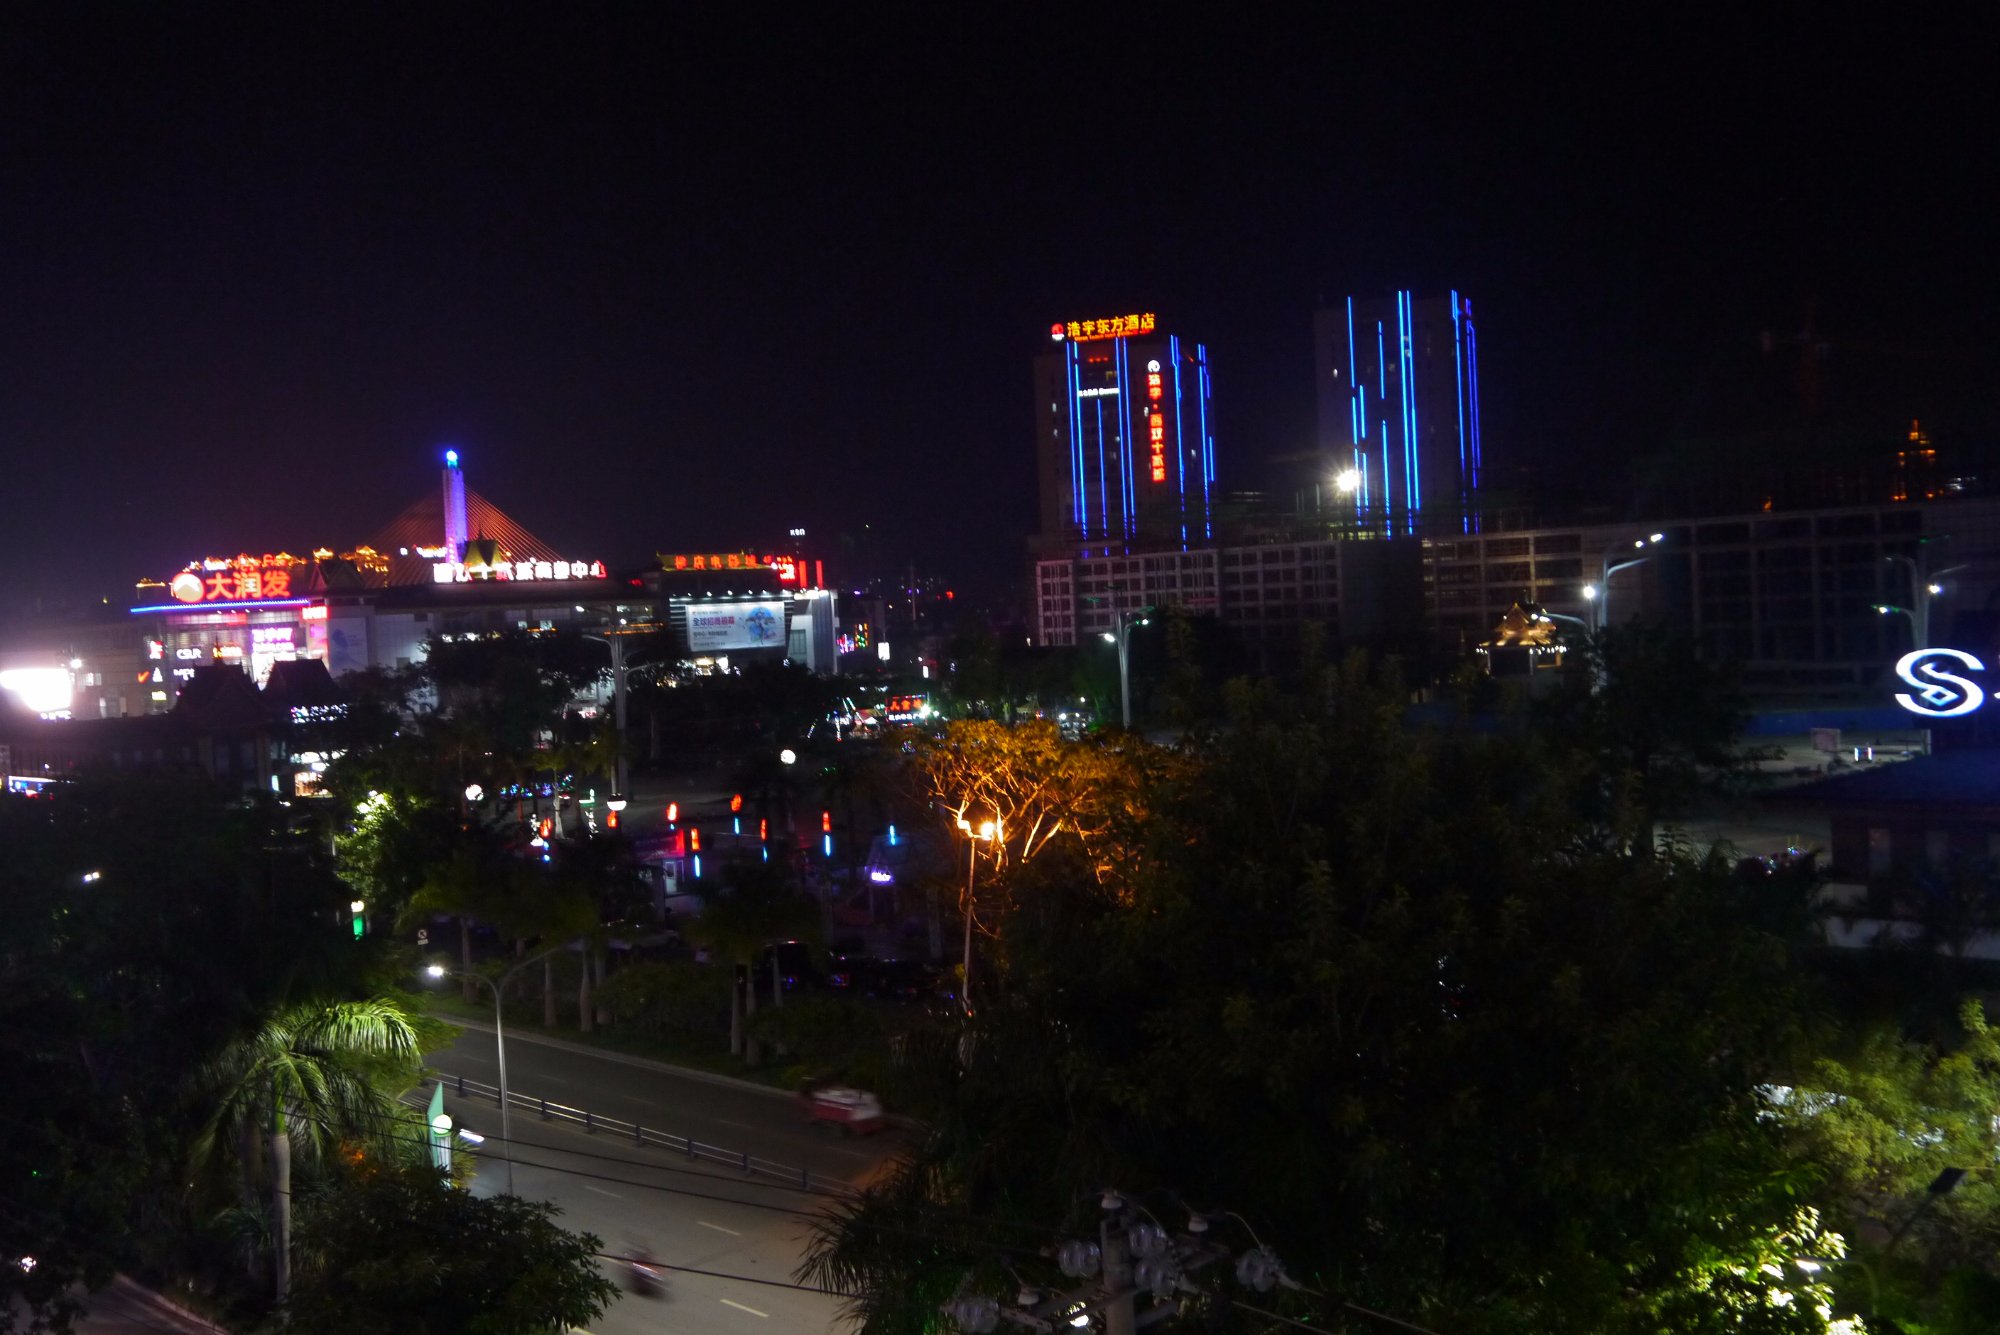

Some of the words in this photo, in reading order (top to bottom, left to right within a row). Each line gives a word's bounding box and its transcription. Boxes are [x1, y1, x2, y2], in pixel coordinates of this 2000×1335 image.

[1067, 313, 1155, 336] 浩宇东方酒店
[205, 571, 290, 599] 大润发
